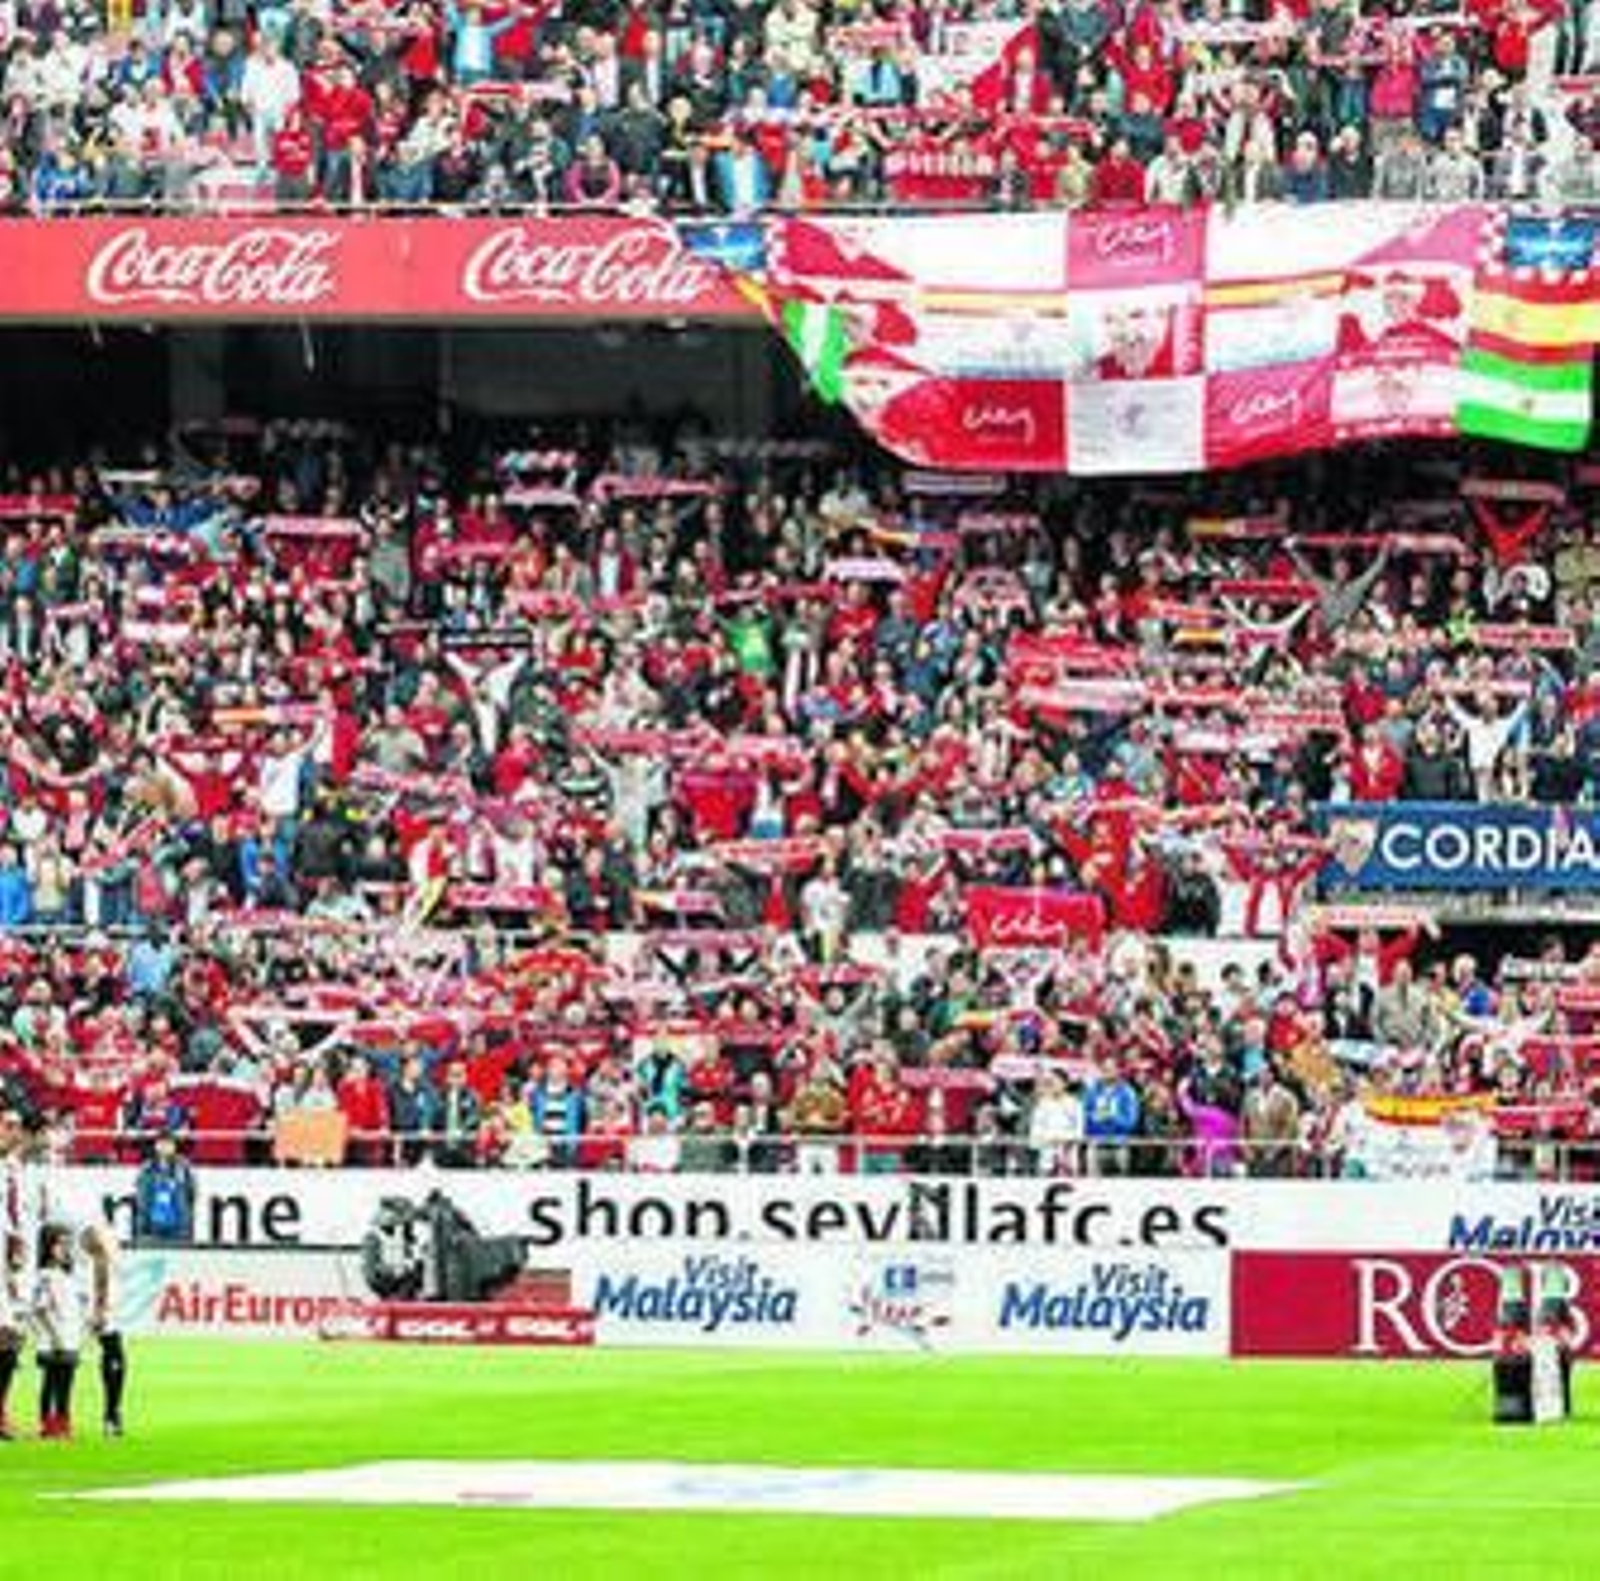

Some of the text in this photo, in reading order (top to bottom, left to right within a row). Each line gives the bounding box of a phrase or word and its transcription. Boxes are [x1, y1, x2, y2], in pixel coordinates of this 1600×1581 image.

[684, 1255, 758, 1289] Visit
[1091, 1262, 1169, 1297] Visit
[594, 1274, 798, 1332] Malaysia
[999, 1282, 1211, 1341] Malaysia
